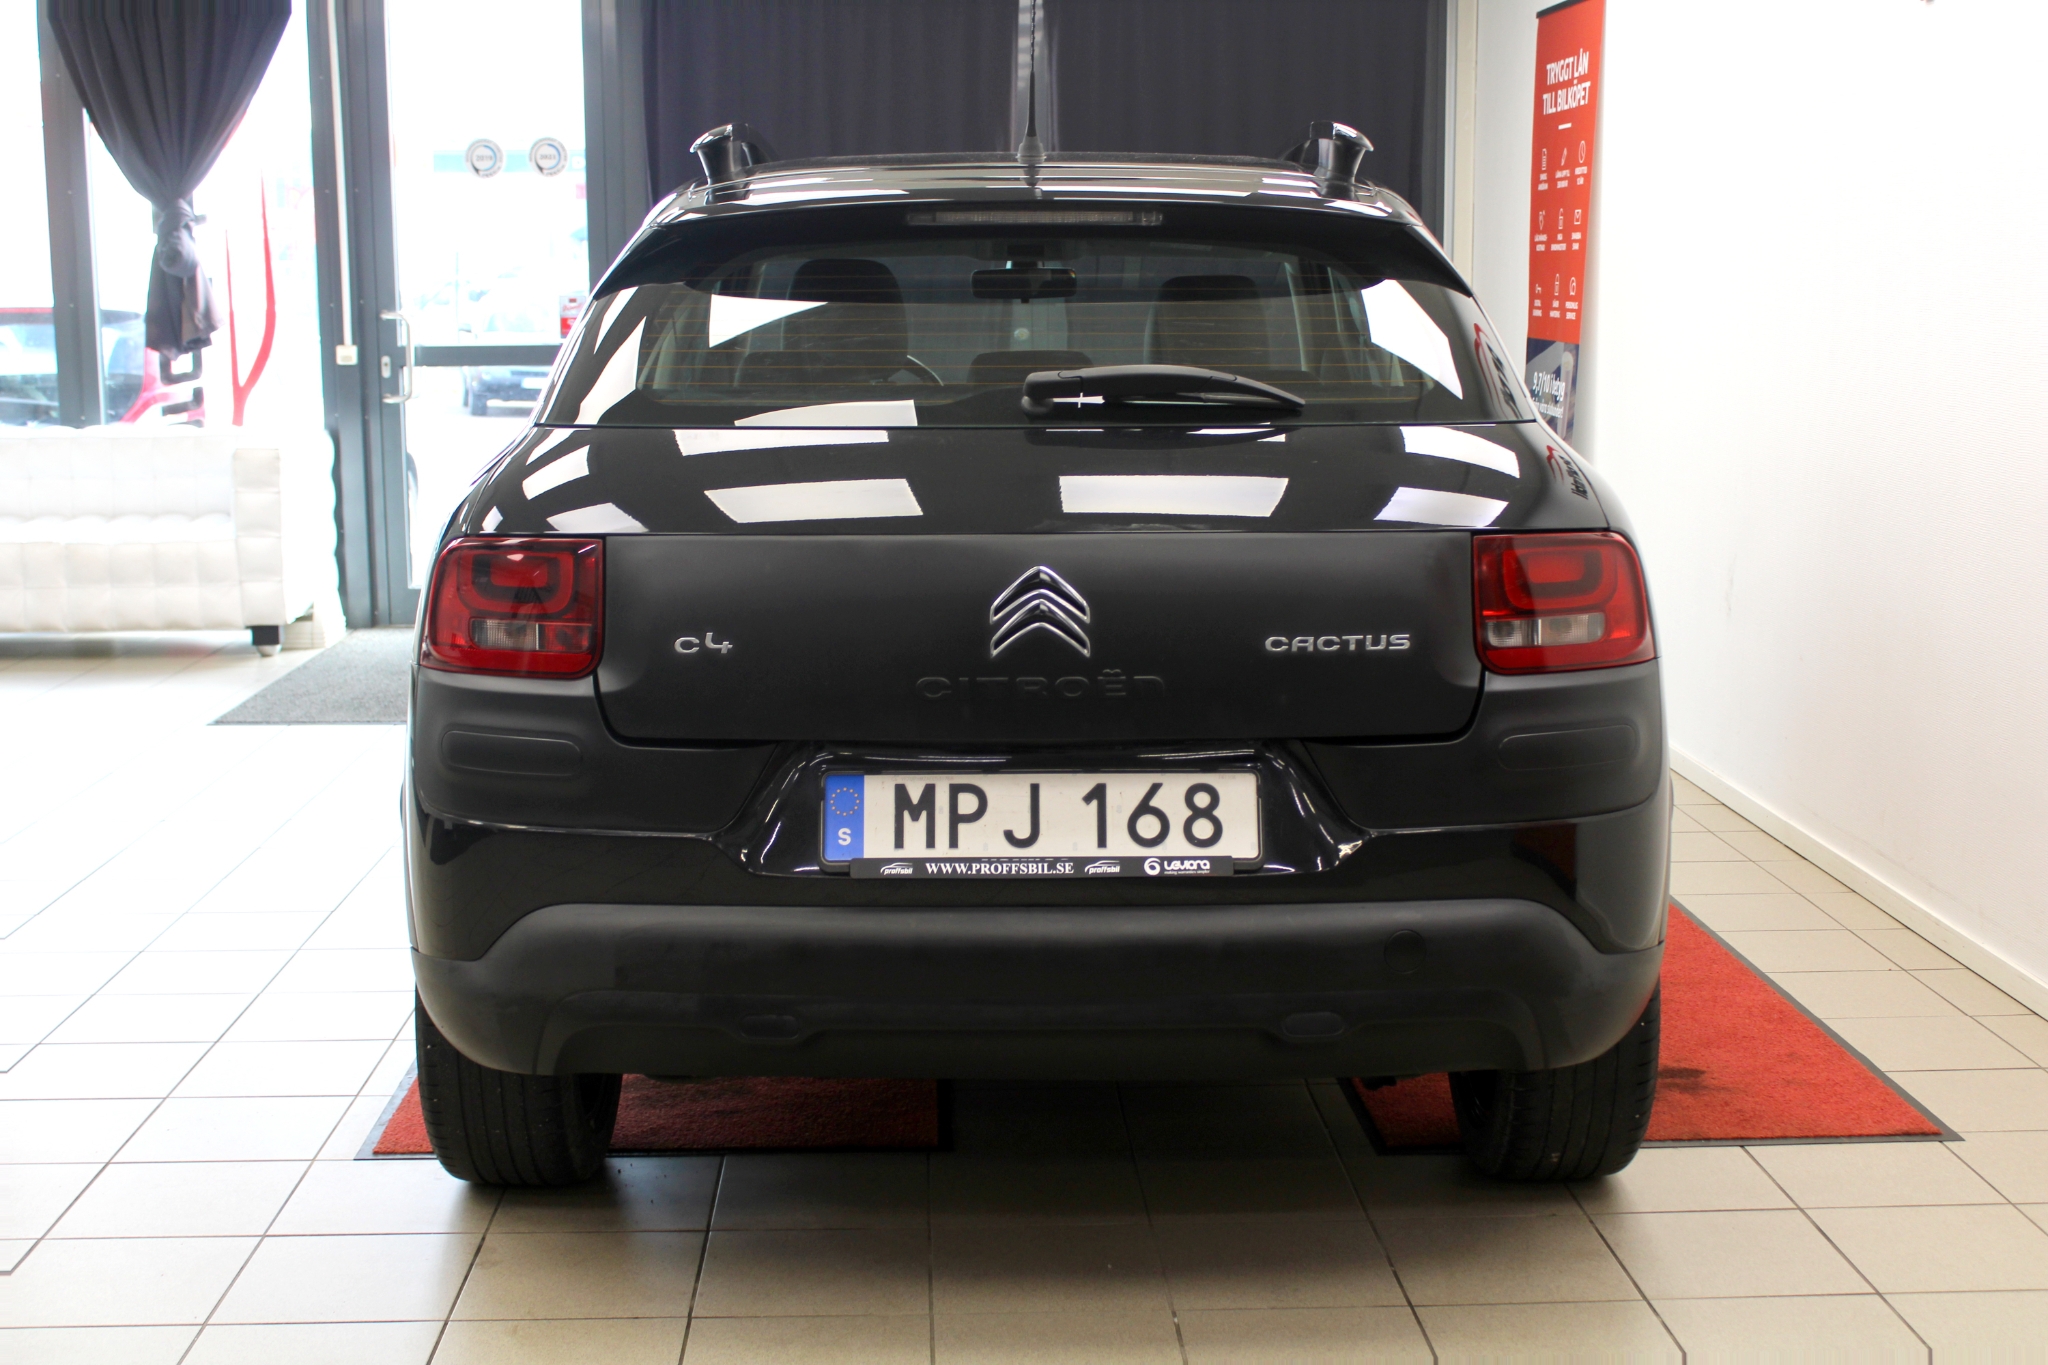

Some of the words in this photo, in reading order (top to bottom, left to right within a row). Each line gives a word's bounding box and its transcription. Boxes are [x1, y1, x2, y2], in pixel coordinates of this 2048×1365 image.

[1546, 56, 1574, 85] TRYGGT
[1573, 48, 1589, 78] LÅN
[1543, 91, 1556, 115] TILL
[1557, 79, 1591, 112] BILKÖPET
[674, 631, 734, 654] C4
[1264, 633, 1411, 653] CACTUS
[915, 668, 1166, 698] CITROËN
[893, 782, 1041, 850] MPJ
[1081, 782, 1224, 849] 168
[837, 827, 852, 845] S
[883, 867, 914, 876] proffsbil
[925, 862, 1075, 875] WWW.PROFFSBIL.SE
[1088, 865, 1120, 875] proffsbil
